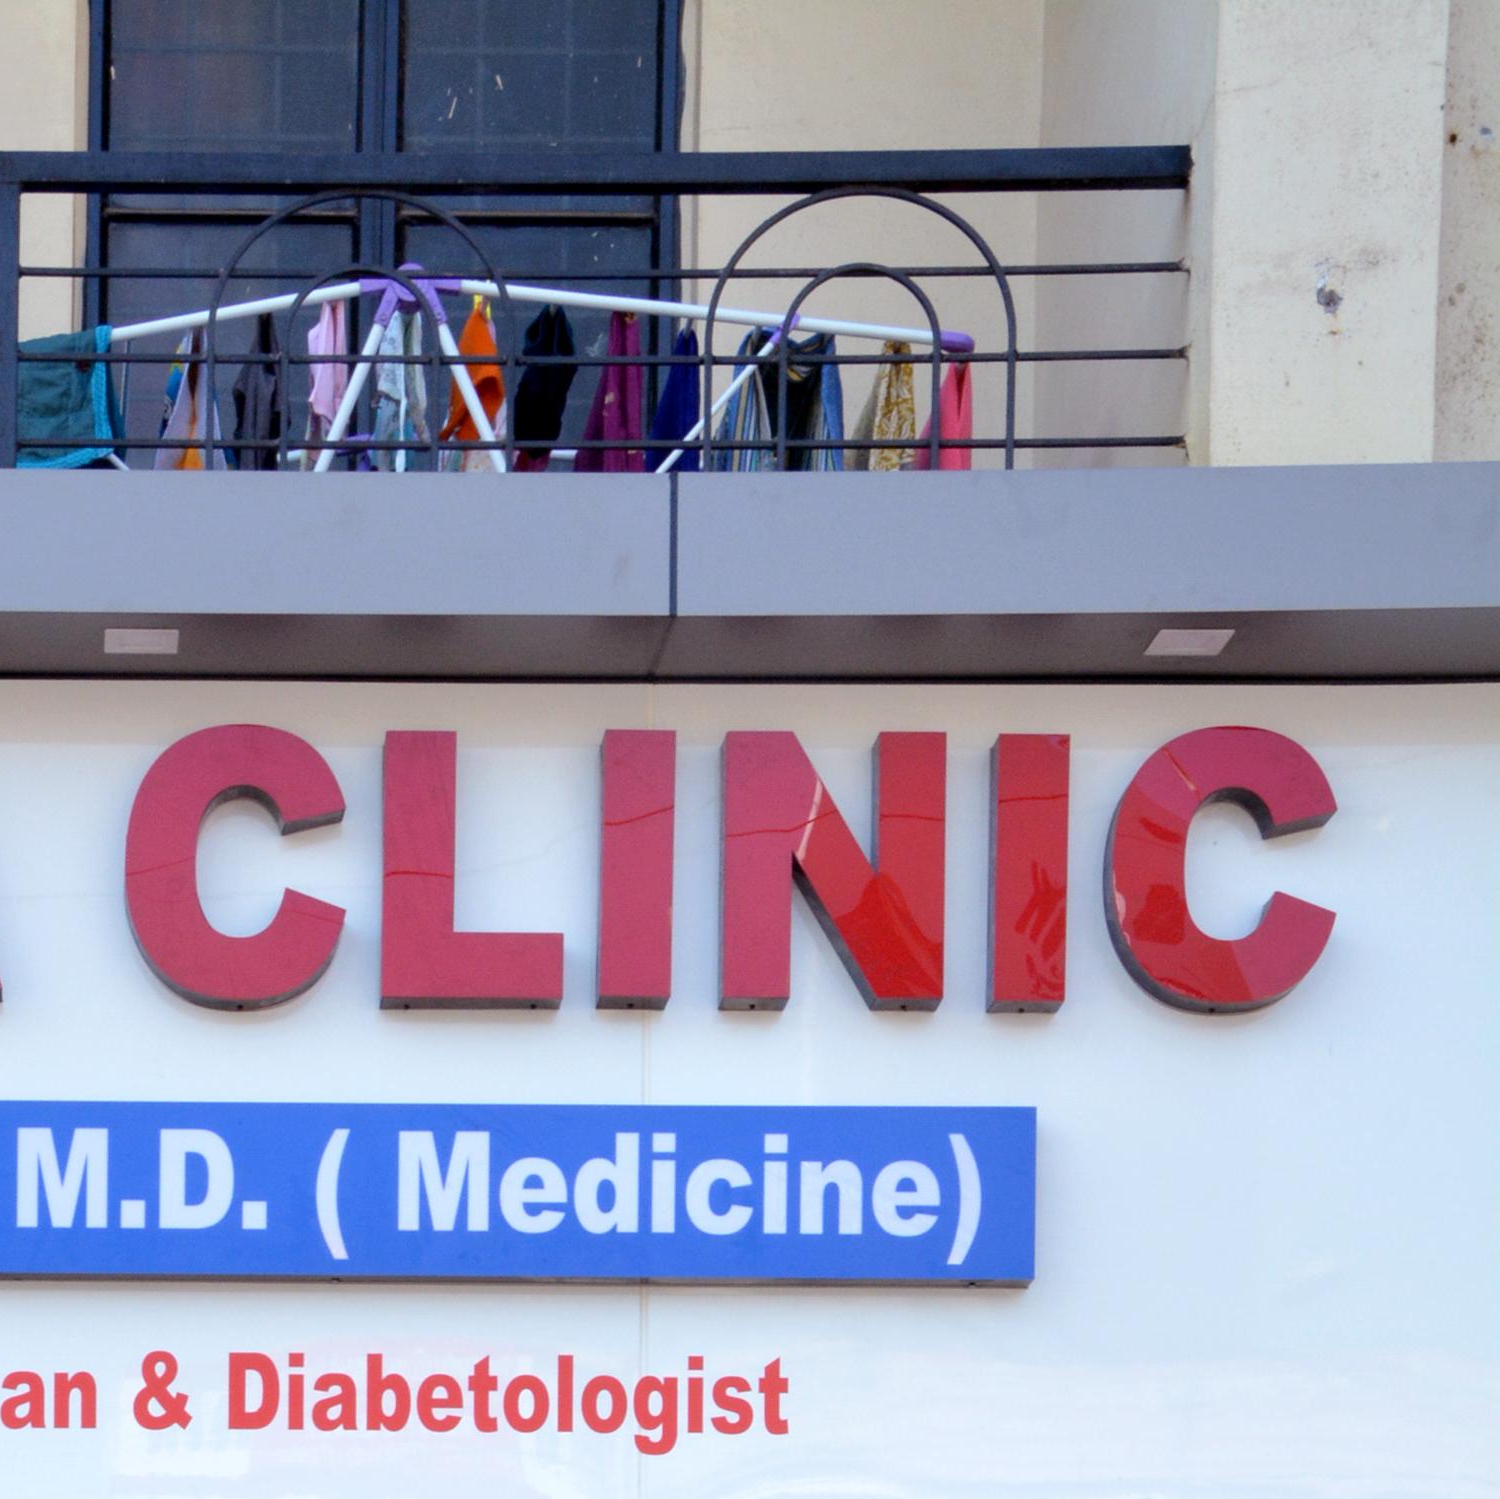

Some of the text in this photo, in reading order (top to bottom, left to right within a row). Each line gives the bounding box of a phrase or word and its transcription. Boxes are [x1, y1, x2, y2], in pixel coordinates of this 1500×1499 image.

[124, 722, 1338, 1014] CLINIC
[13, 1126, 269, 1231] M.D.
[132, 1349, 192, 1430] &
[226, 1351, 789, 1456] Diabetologist
